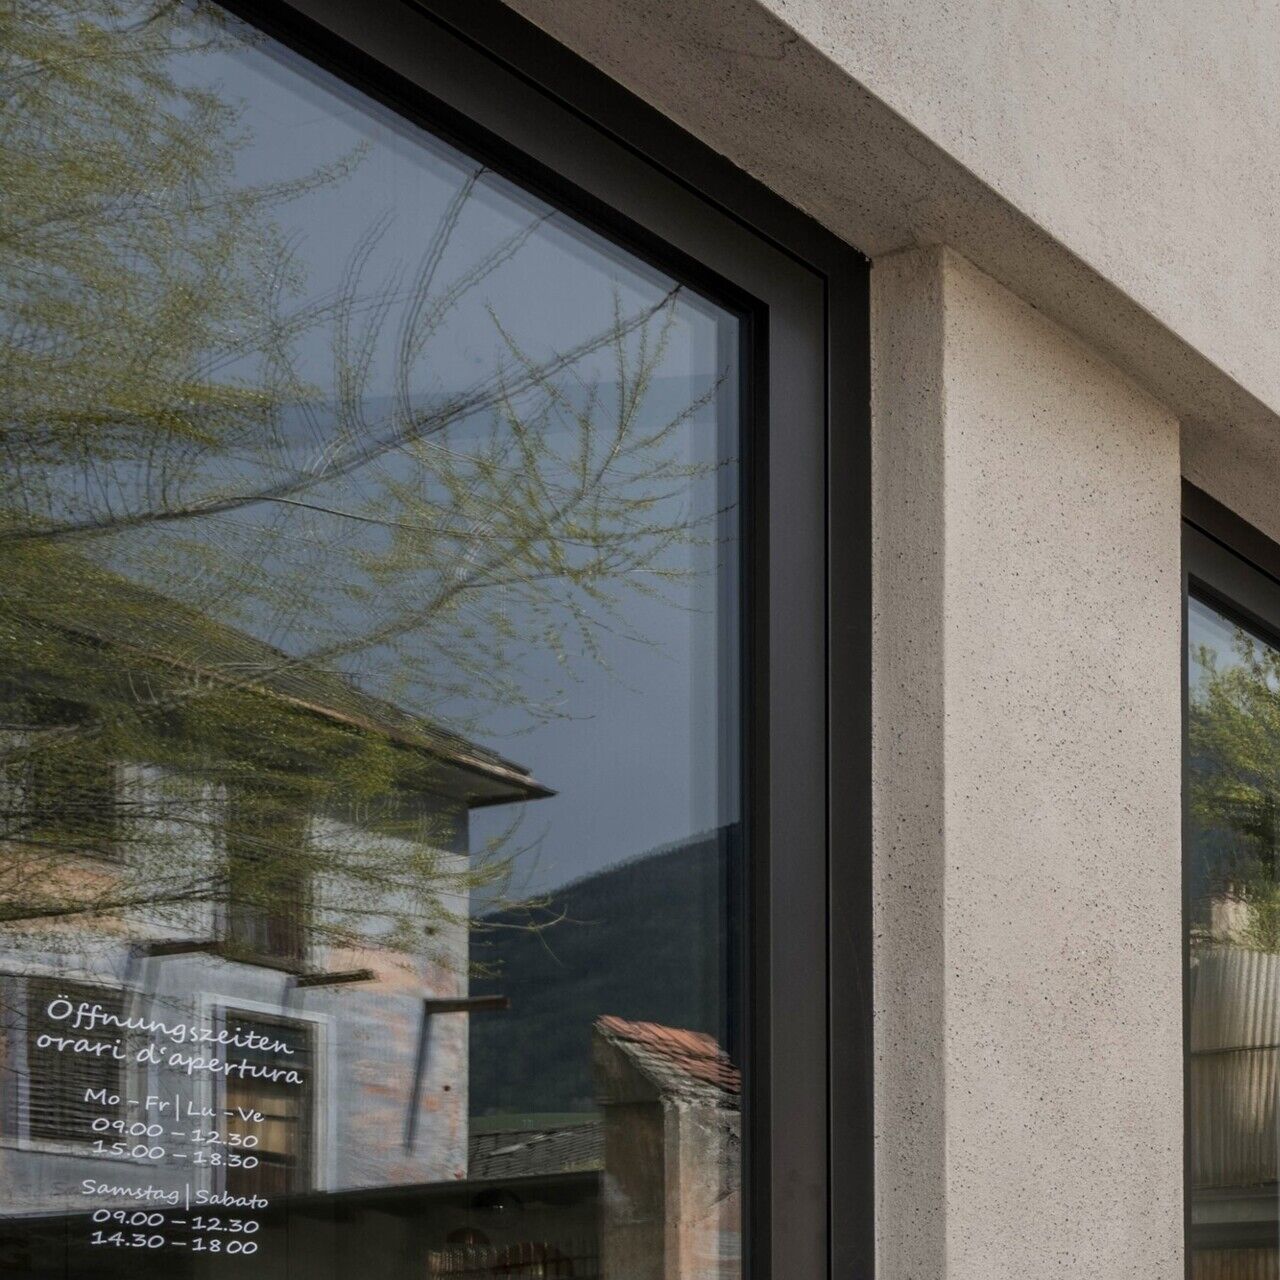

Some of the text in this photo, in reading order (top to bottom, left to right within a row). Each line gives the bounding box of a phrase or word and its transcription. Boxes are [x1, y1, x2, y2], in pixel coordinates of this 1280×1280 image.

[47, 995, 295, 1054] Öffnungszeiten
[36, 1034, 127, 1060] orari
[84, 1088, 121, 1106] Mo
[145, 1095, 170, 1112] Fr
[187, 1101, 216, 1117] Lu
[238, 1107, 265, 1123] Ve
[91, 1118, 164, 1137] 09.00
[191, 1129, 259, 1149] 12.30
[92, 1140, 165, 1160] 15.00
[192, 1151, 259, 1170] 18.30
[81, 1179, 180, 1206] Samstag
[195, 1188, 269, 1210] Sabato
[92, 1209, 165, 1227] 09.00
[191, 1215, 259, 1234] 12.30
[90, 1231, 165, 1249] 14.30
